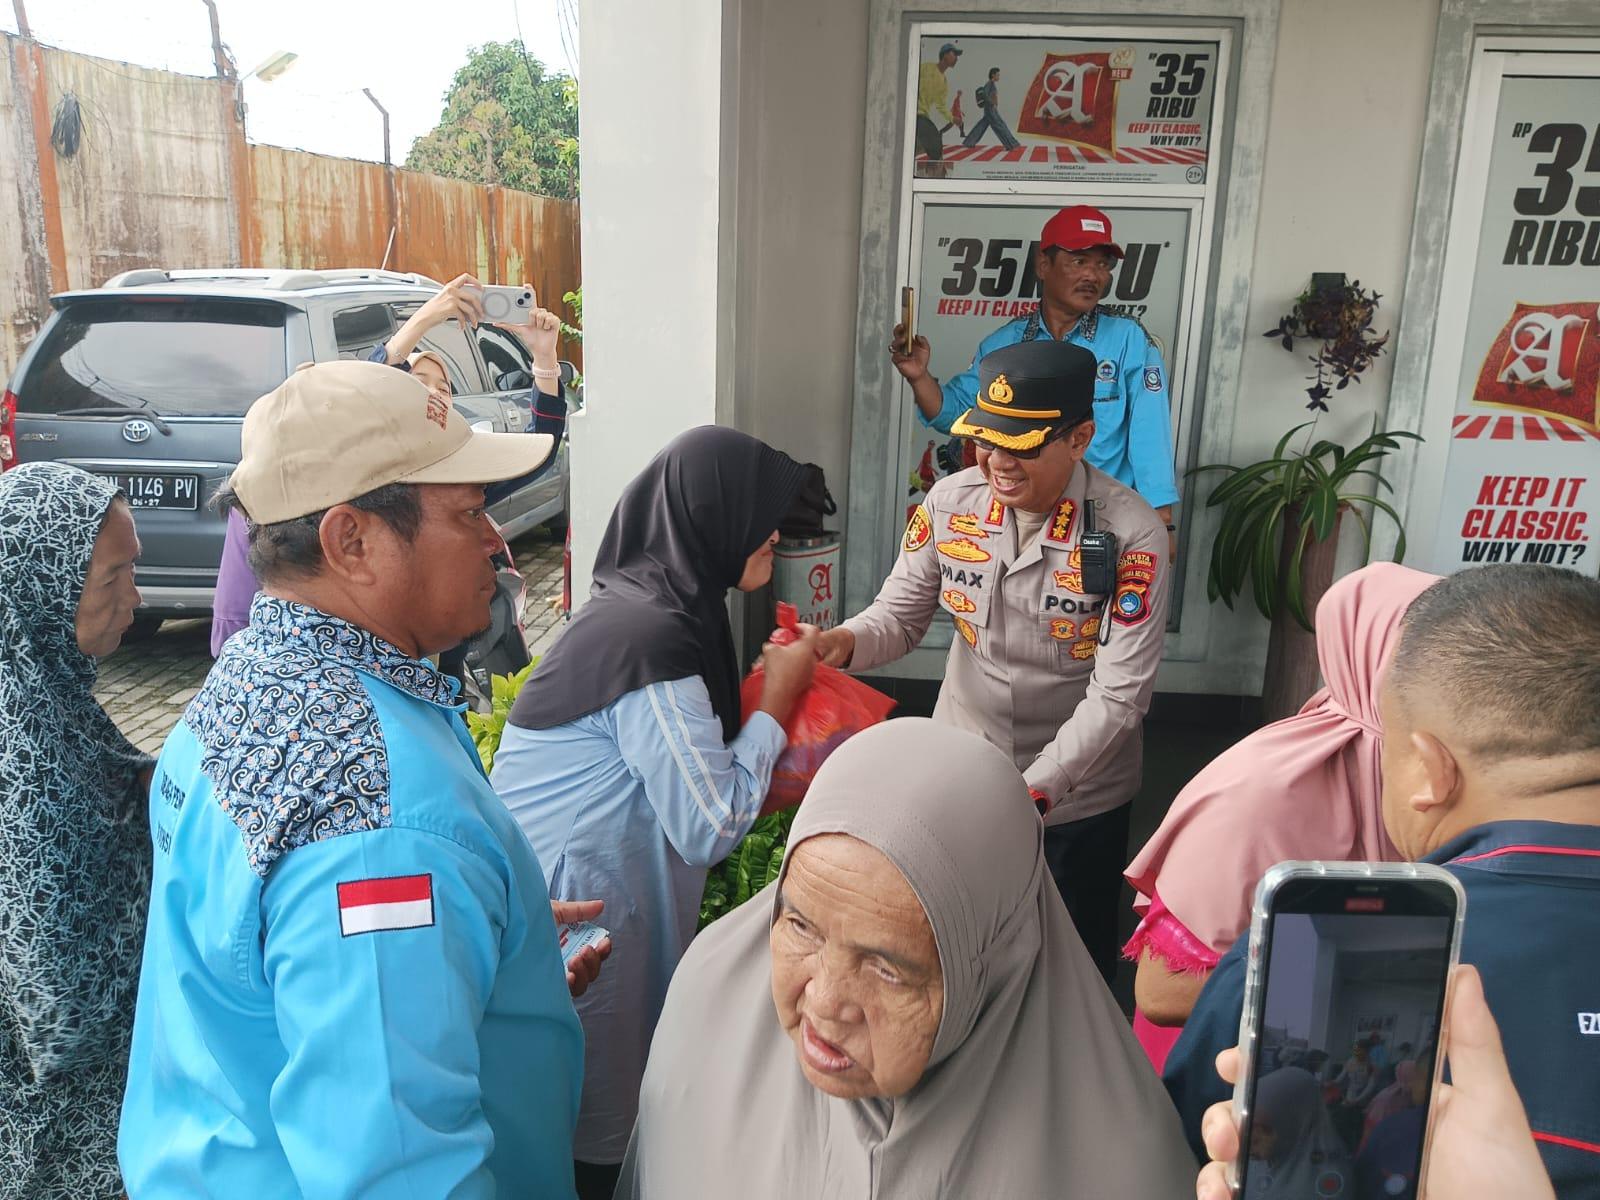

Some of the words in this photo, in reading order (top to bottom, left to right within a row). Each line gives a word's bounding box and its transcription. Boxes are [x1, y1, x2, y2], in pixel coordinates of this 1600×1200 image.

[1150, 53, 1210, 95] 35
[1146, 97, 1197, 118] RIBU
[1128, 123, 1150, 134] KEEP
[1151, 123, 1162, 134] IT
[1512, 122, 1533, 138] RP
[1150, 135, 1174, 146] WHY
[1175, 136, 1202, 146] NOT?
[936, 298, 973, 316] KEEP
[973, 300, 990, 316] IT
[128, 476, 164, 497] 1146
[175, 478, 193, 498] PV
[1476, 475, 1550, 507] KEEP
[1550, 477, 1587, 508] IT
[1461, 508, 1589, 542] CLASSIC.
[1462, 541, 1520, 564] WHY
[1520, 541, 1587, 565] NOT?
[941, 563, 984, 589] MAX
